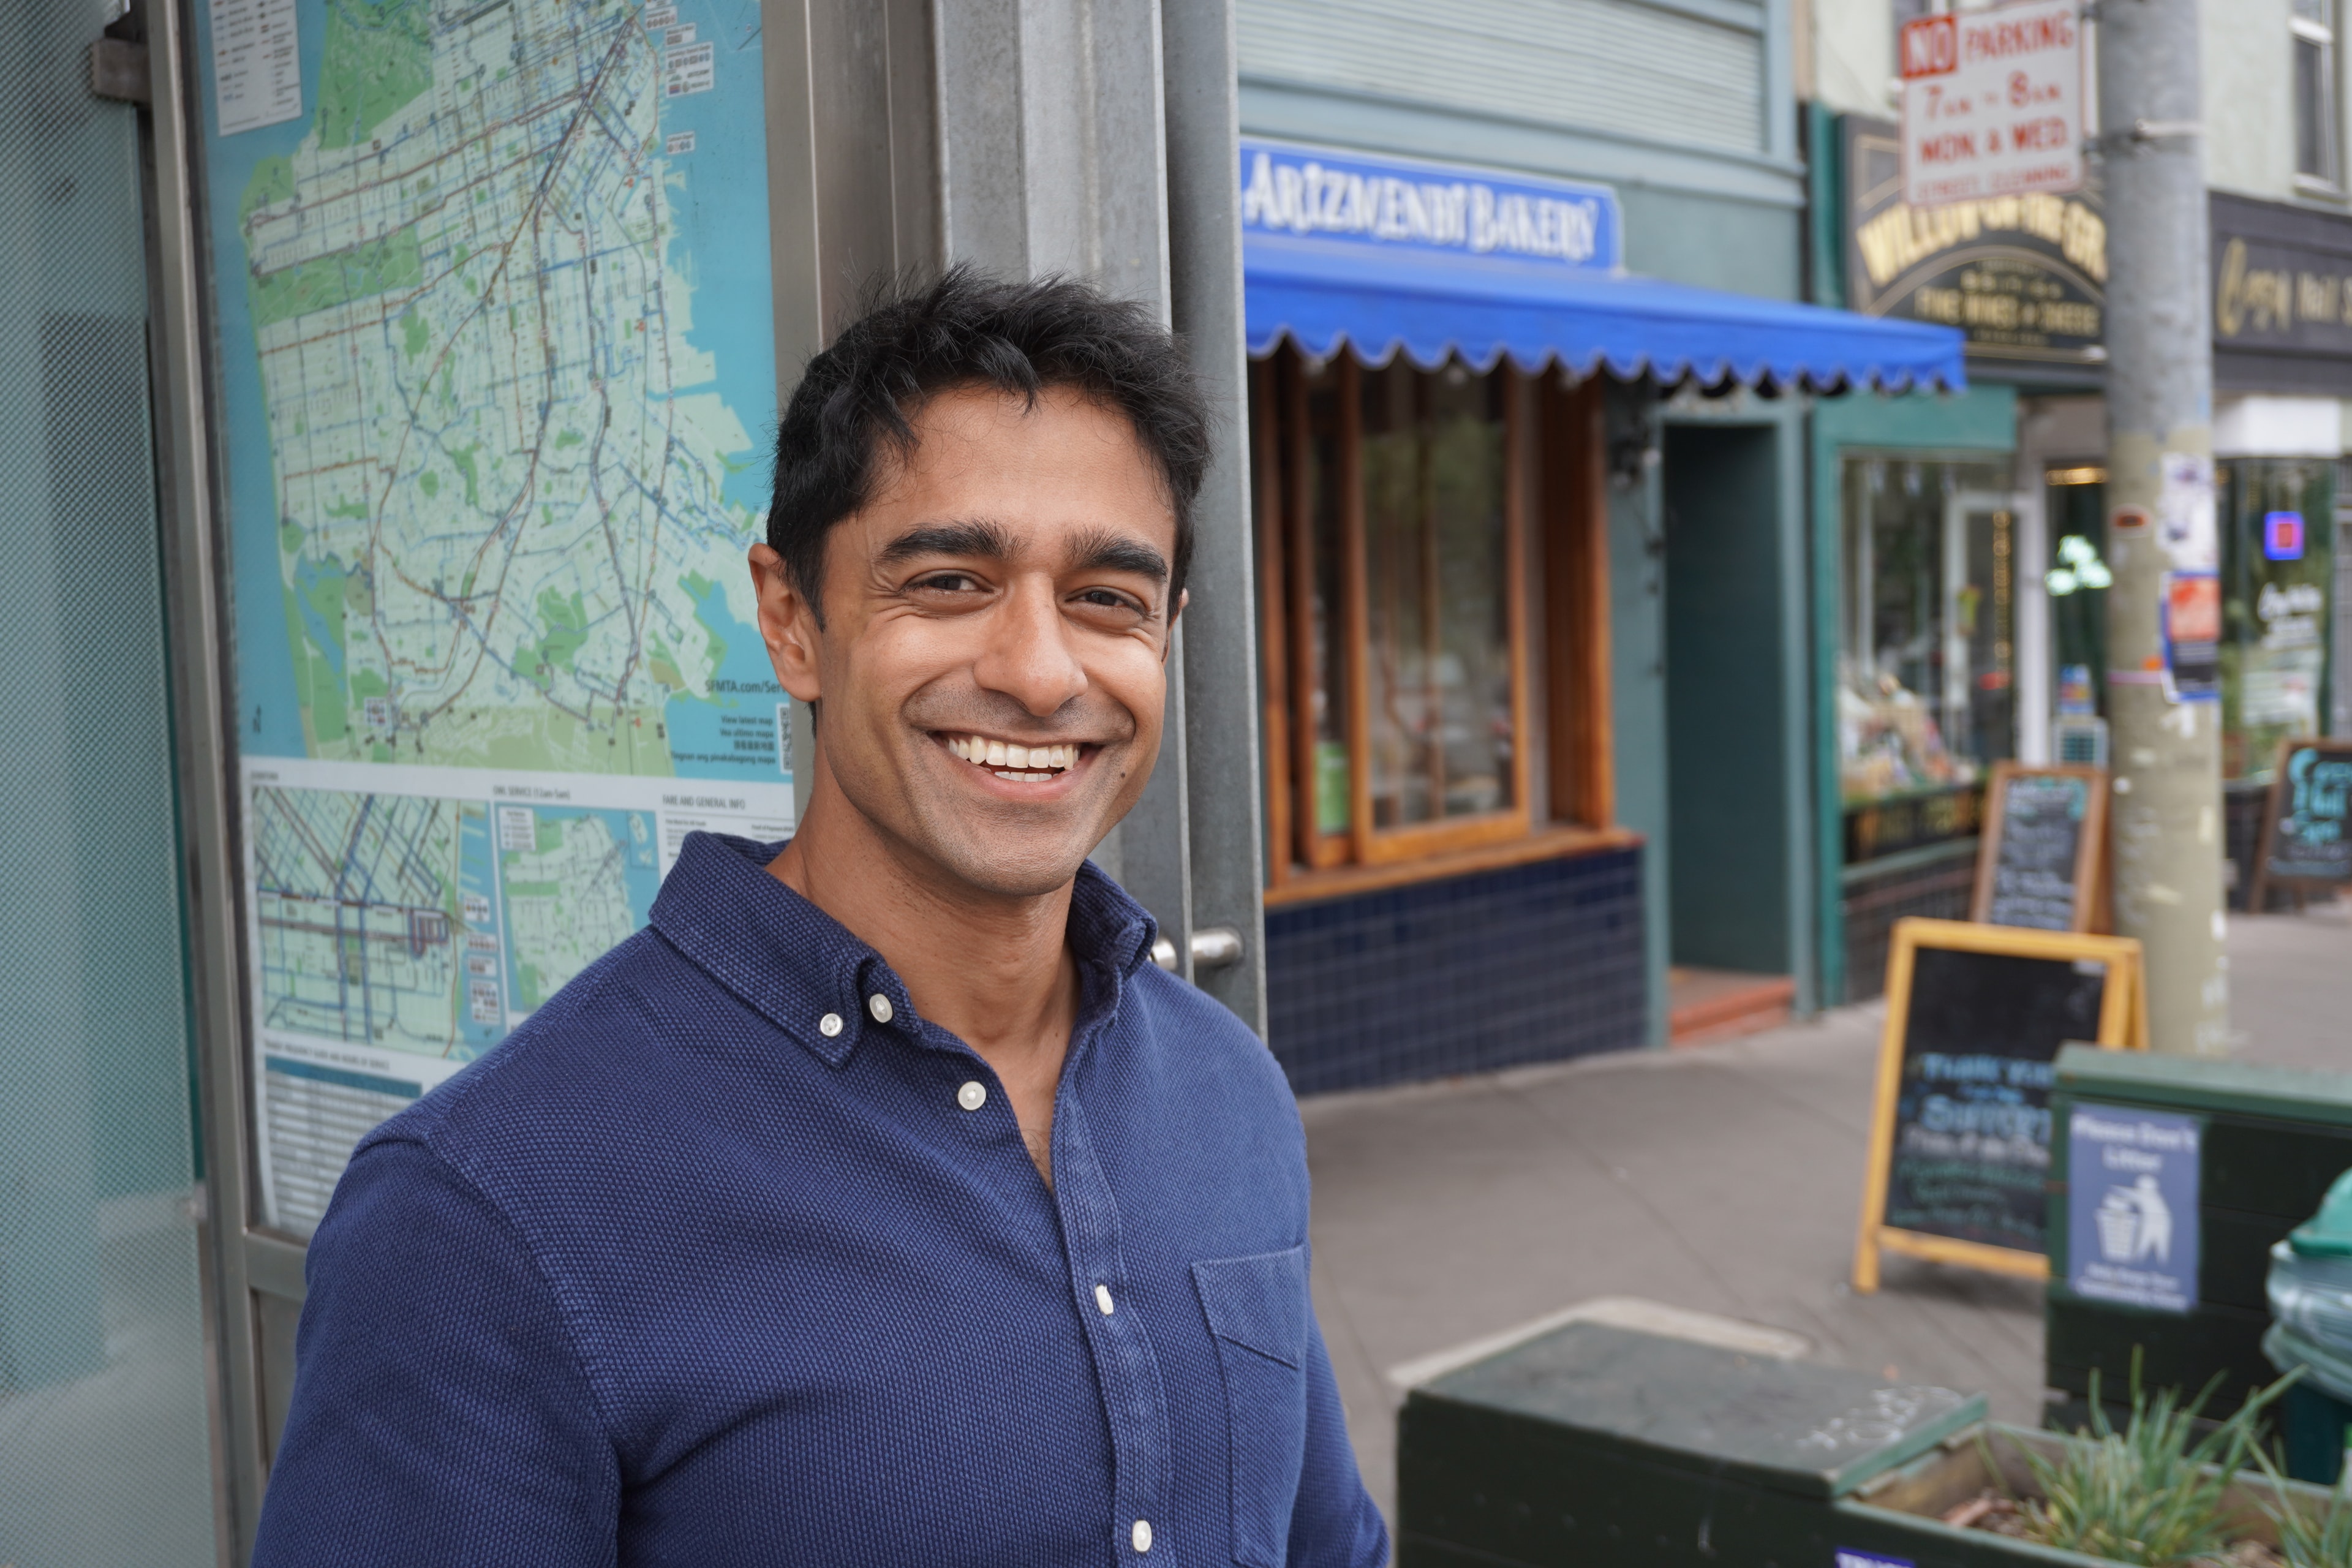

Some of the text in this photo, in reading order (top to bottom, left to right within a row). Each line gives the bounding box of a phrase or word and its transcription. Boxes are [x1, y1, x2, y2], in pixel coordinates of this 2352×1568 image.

[1907, 14, 2075, 72] NO PARKING
[1471, 183, 1599, 263] BAKERY
[721, 715, 773, 726] View latest map
[663, 794, 745, 810] FARE AND GENERAL INFO
